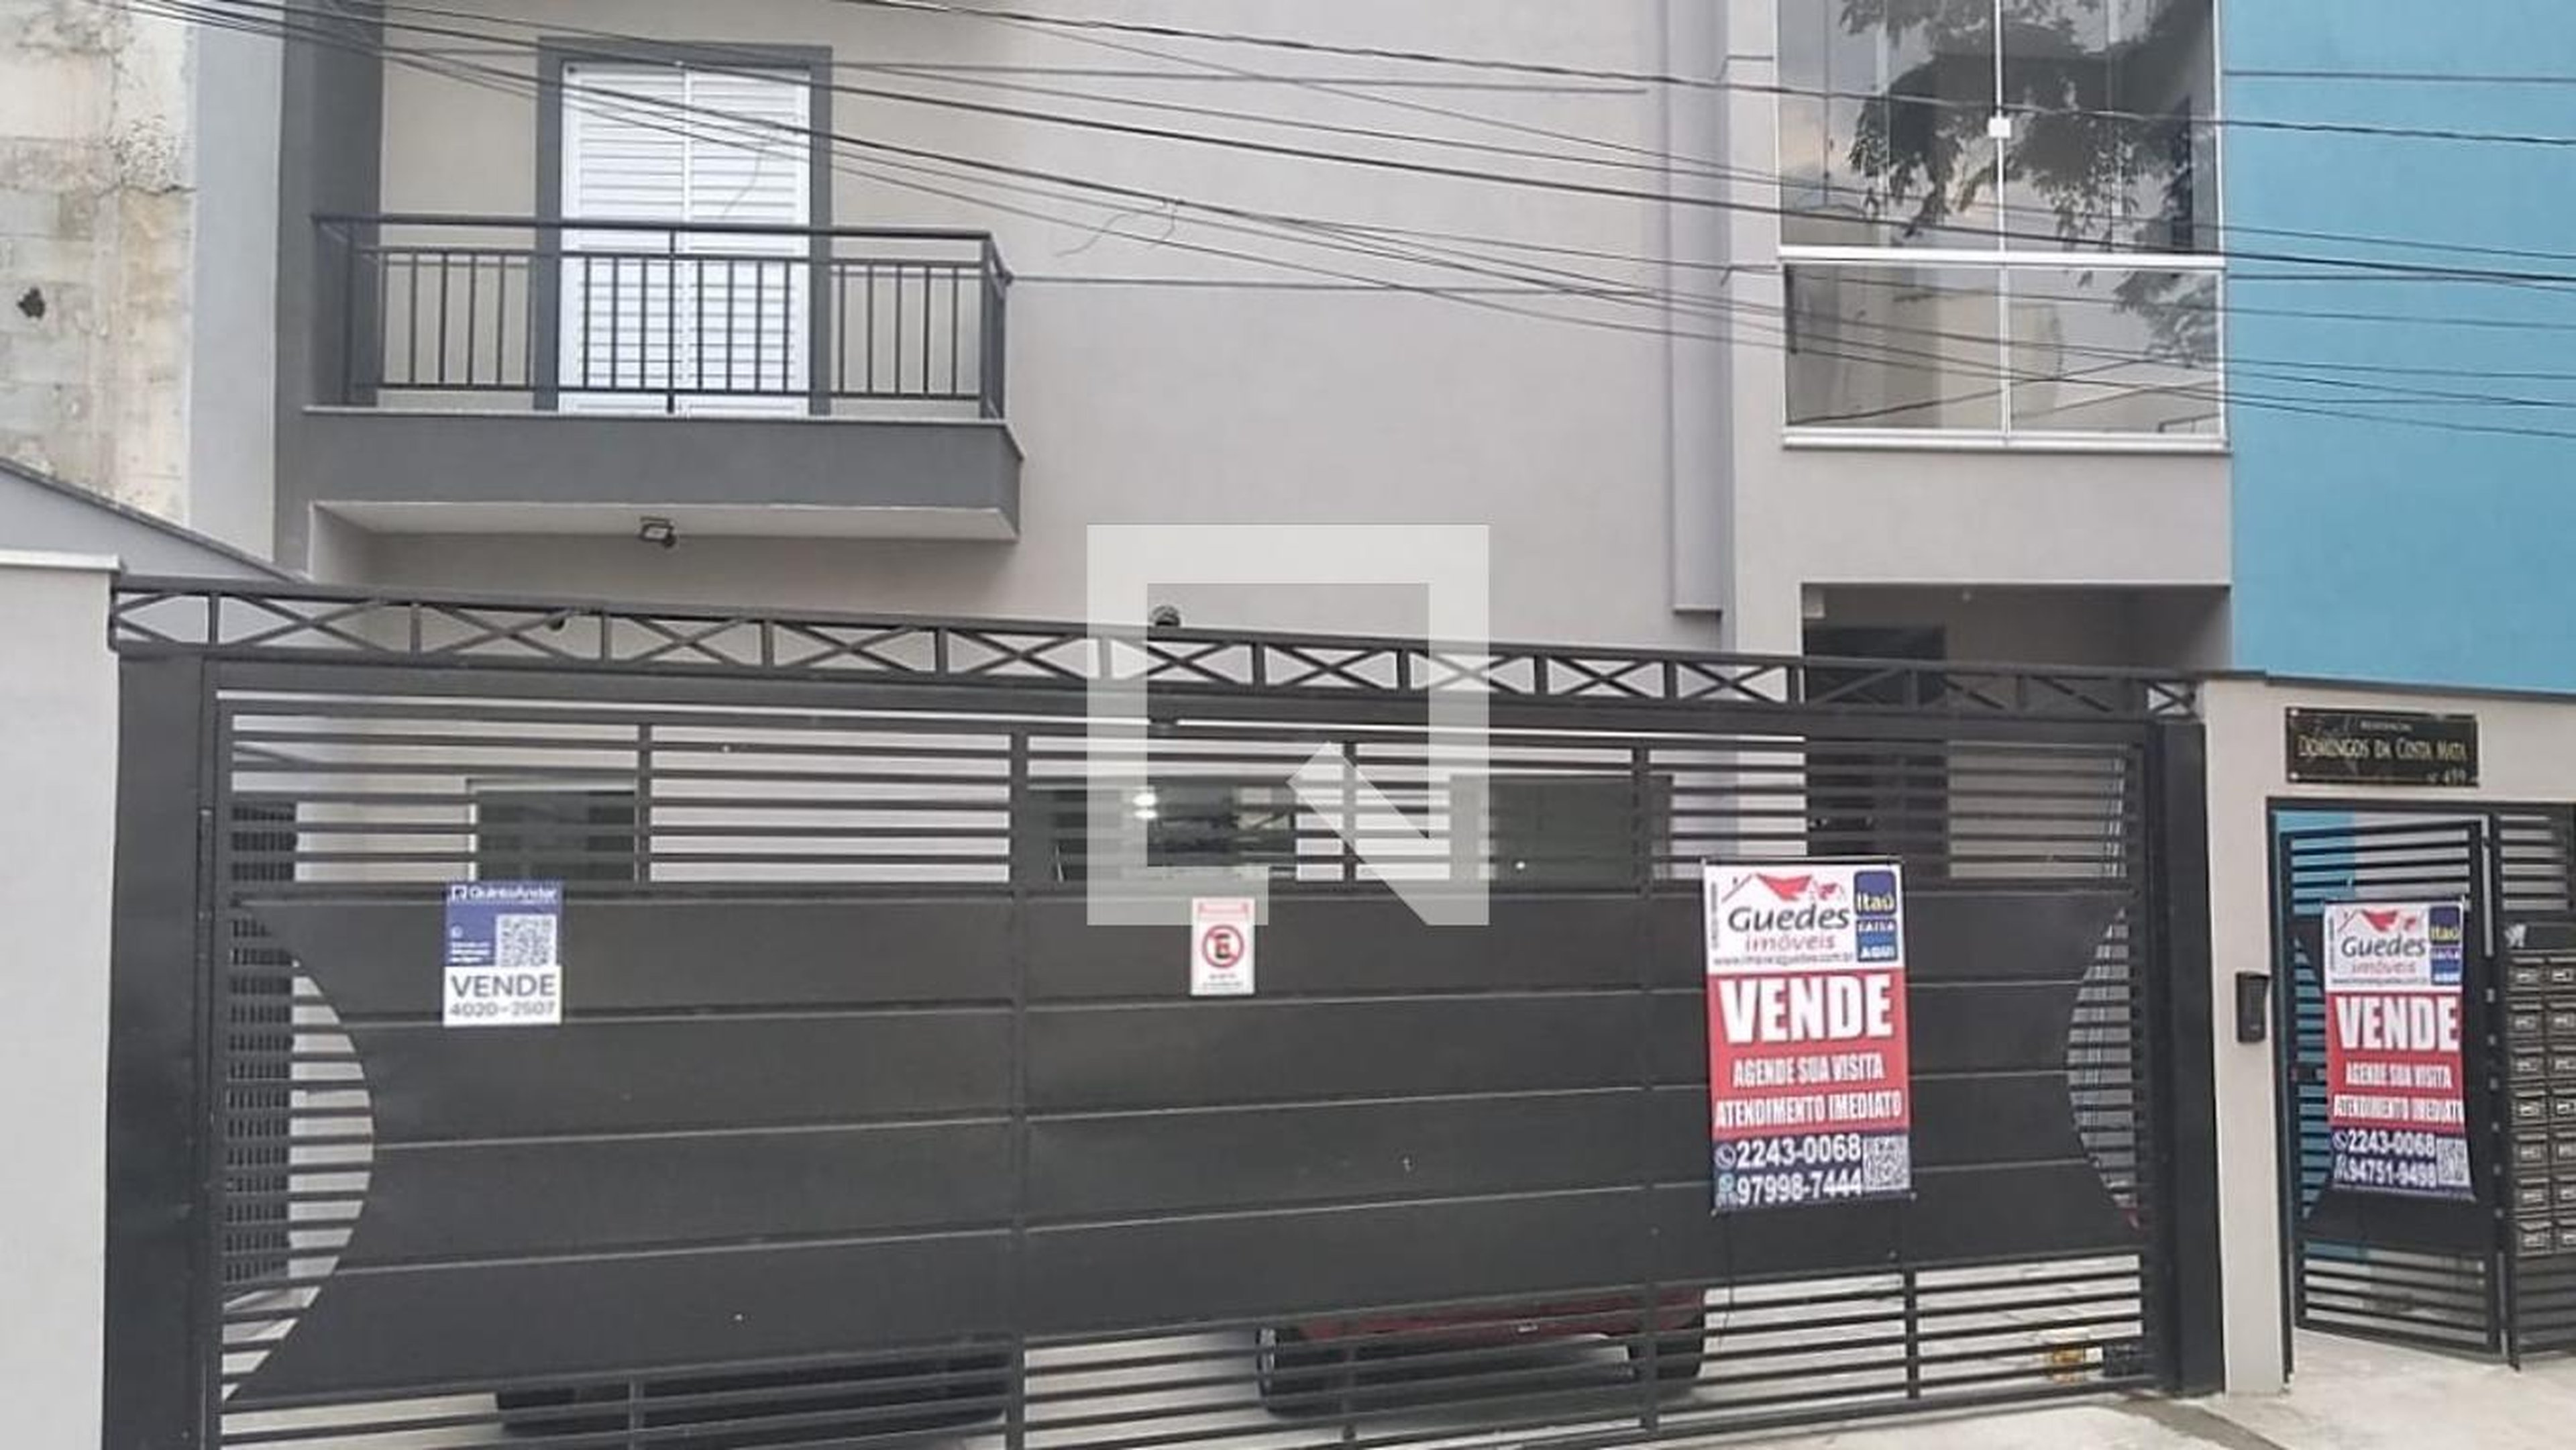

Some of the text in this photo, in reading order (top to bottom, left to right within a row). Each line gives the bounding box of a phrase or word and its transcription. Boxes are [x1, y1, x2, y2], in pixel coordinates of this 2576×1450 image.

[1728, 903, 1849, 933] Guedes
[1746, 934, 1835, 952] imóveis
[2341, 933, 2426, 957] Guedes
[450, 974, 556, 998] VENDE
[1719, 973, 1893, 1043] VENDE
[2335, 996, 2460, 1051] VENDE
[1733, 1051, 1884, 1088] AGENDE SUA VISITA
[1715, 1090, 1902, 1129] ATENDIMENTO IMEDIATO
[1736, 1133, 1861, 1168] 2243-0068
[2348, 1129, 2436, 1158] 2243-0068
[1737, 1169, 1862, 1205] 97998-7444
